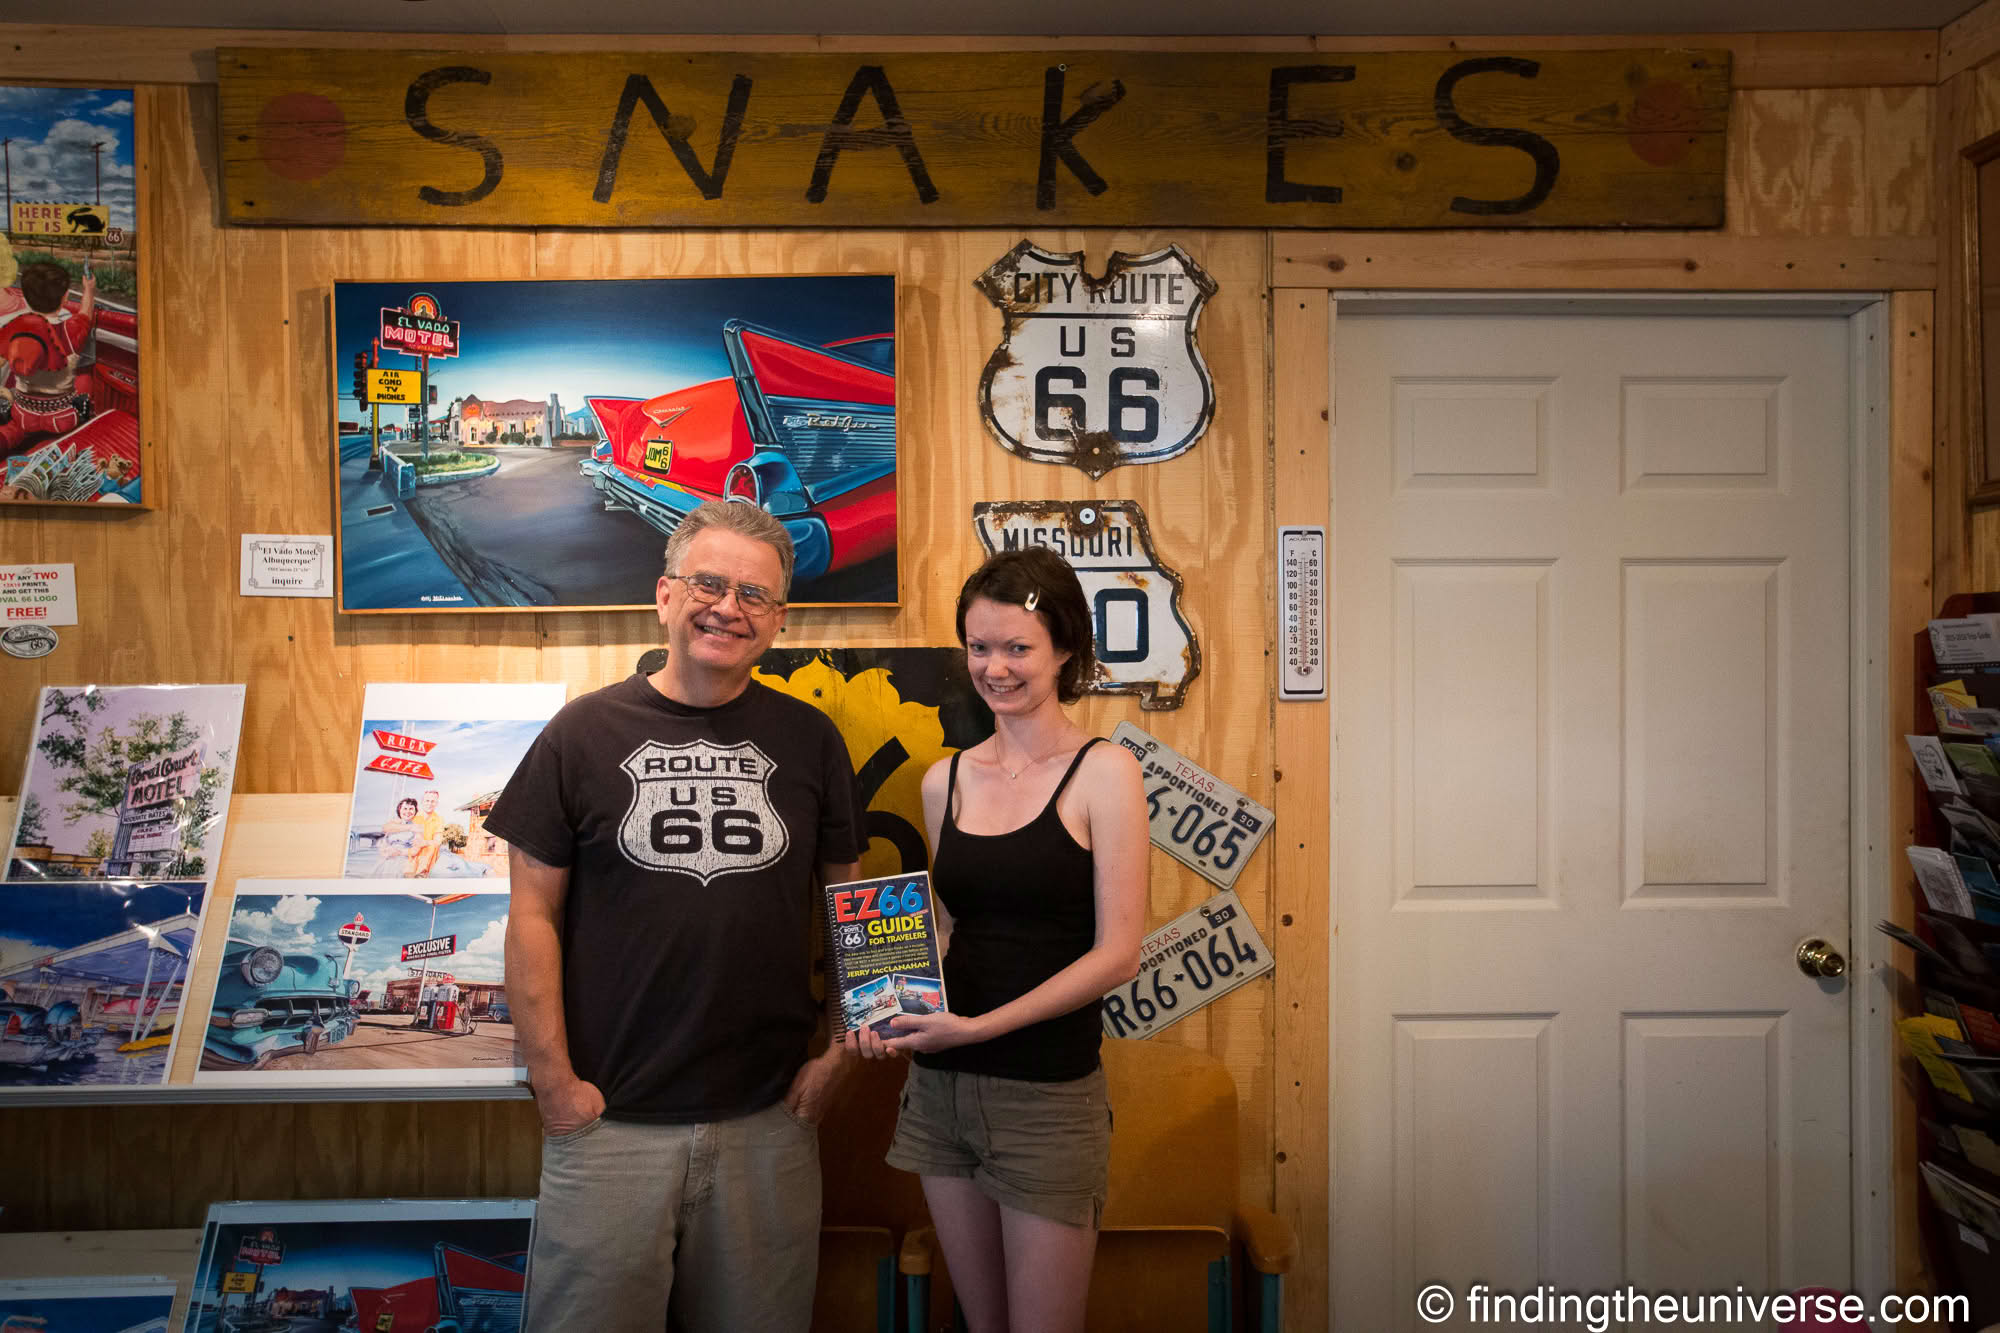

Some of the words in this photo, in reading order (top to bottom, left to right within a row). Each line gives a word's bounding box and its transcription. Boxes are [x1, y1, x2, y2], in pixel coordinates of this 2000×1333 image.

[404, 56, 1560, 215] SNAKES
[18, 207, 62, 219] HERE
[18, 221, 37, 232] IT
[45, 221, 61, 232] IS
[107, 231, 120, 242] 66
[1013, 272, 1078, 304] CITY
[1089, 273, 1185, 305] ROUTE
[398, 316, 413, 328] EL
[417, 319, 450, 334] VADO
[384, 325, 455, 348] MOTEL
[376, 393, 406, 401] PHONES
[1034, 365, 1160, 444] 66
[1002, 526, 1133, 558] MISSOURI
[273, 547, 293, 555] Vado
[1309, 559, 1318, 567] 60
[0, 572, 15, 581] UY
[32, 571, 58, 580] TWO
[1309, 569, 1318, 577] 50
[272, 576, 303, 586] inquire
[1309, 579, 1318, 587] 40
[1309, 589, 1318, 597] 30
[7, 606, 48, 617] FREE!
[1309, 658, 1319, 666] 40
[387, 734, 426, 754] ROCK
[1120, 738, 1145, 759] MAR
[380, 758, 424, 773] CAFE
[644, 755, 758, 775] ROUTE
[1173, 761, 1216, 793] TEXAS
[131, 775, 186, 805] MOTEL
[1145, 761, 1229, 818] APPORTIONED
[1238, 814, 1255, 828] 90
[650, 808, 764, 855] 66
[834, 882, 925, 923] EZ66
[1214, 910, 1231, 924] 90
[867, 915, 926, 936] GUIDE
[341, 929, 370, 938] STANDARD
[844, 933, 861, 945] 66
[868, 937, 886, 946] FOR
[887, 931, 928, 944] TRAVELERS
[407, 937, 450, 956] EXCLUSIVE
[1140, 927, 1182, 956] TEXAS
[1136, 927, 1208, 976] PORTIONED
[846, 968, 870, 979] JERRY
